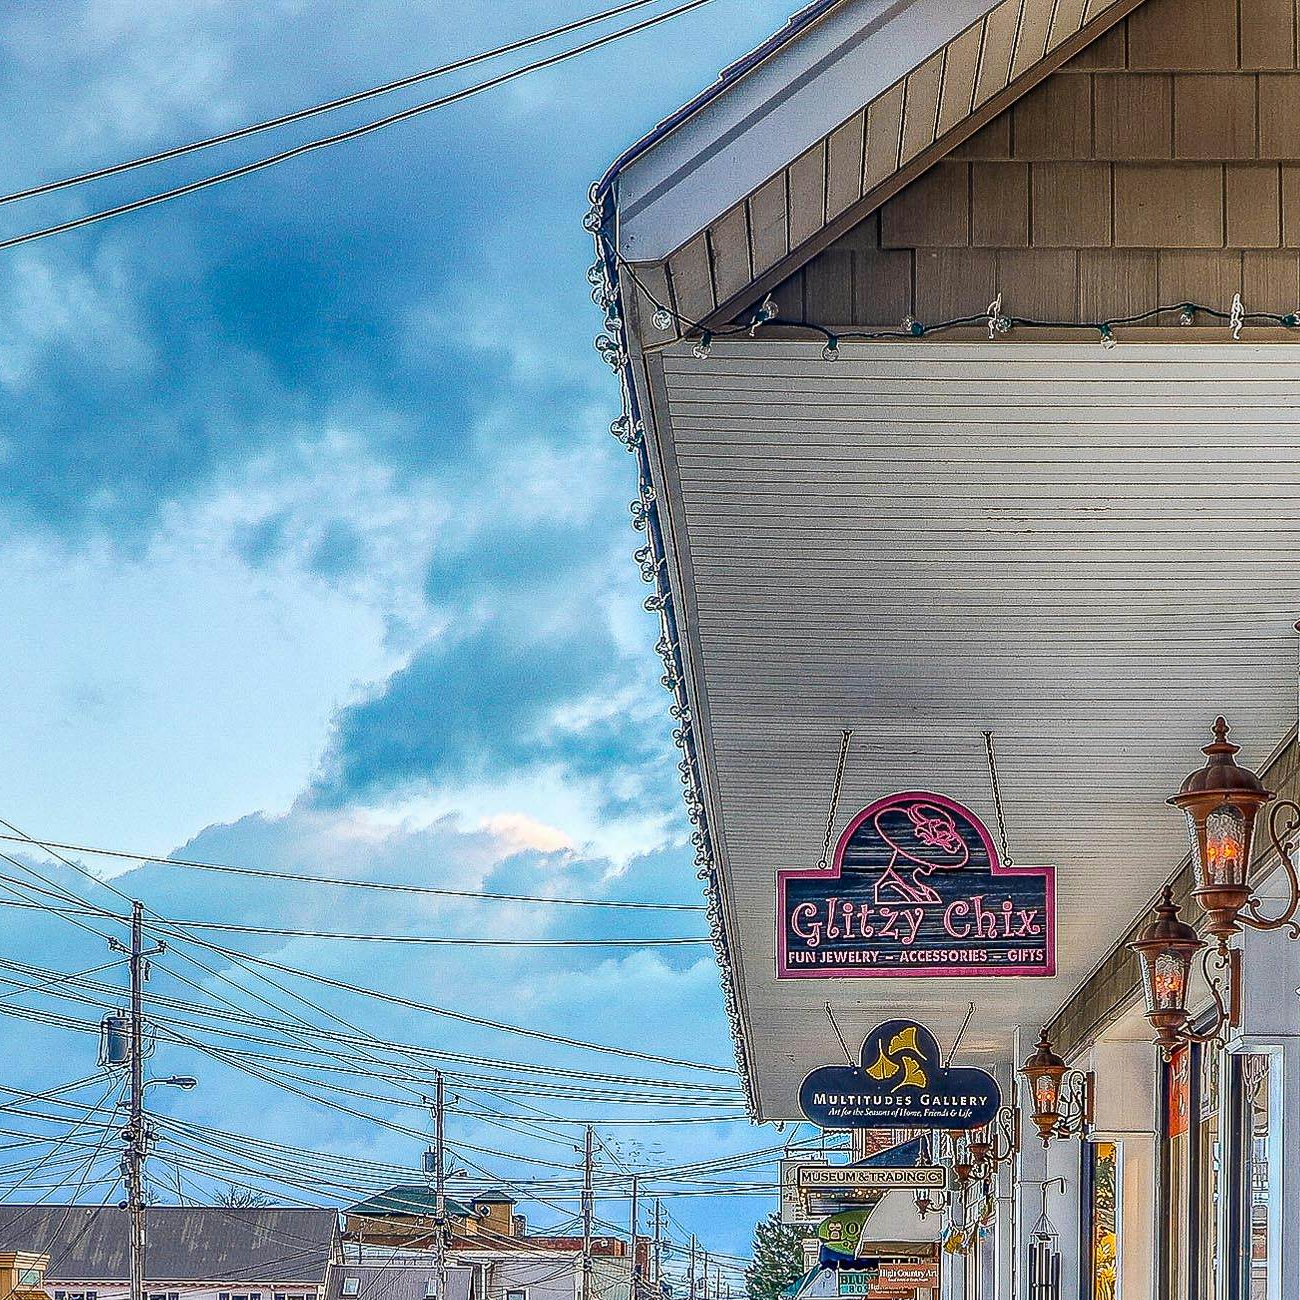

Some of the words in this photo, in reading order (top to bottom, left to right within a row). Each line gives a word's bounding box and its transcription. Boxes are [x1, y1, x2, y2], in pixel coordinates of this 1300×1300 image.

[791, 897, 925, 947] Glitzy
[943, 895, 1042, 940] Chix
[788, 950, 817, 964] FUN
[819, 950, 880, 963] JEWELRY
[899, 949, 988, 963] ACCESSORIES
[1006, 949, 1045, 962] GIFTS
[813, 1093, 912, 1106] MULTITUDES
[920, 1093, 988, 1106] GALLERY
[828, 1107, 841, 1117] Art
[840, 1107, 852, 1118] for
[852, 1107, 864, 1116] the
[864, 1107, 891, 1117] Seasons
[891, 1107, 900, 1118] of
[923, 1107, 949, 1117] Friends
[949, 1108, 958, 1117] &
[958, 1107, 973, 1118] Life
[801, 1171, 856, 1182] MUSEUM
[858, 1172, 870, 1182] &
[870, 1172, 926, 1182] TRADING
[879, 1269, 897, 1278] High
[896, 1269, 925, 1278] Country
